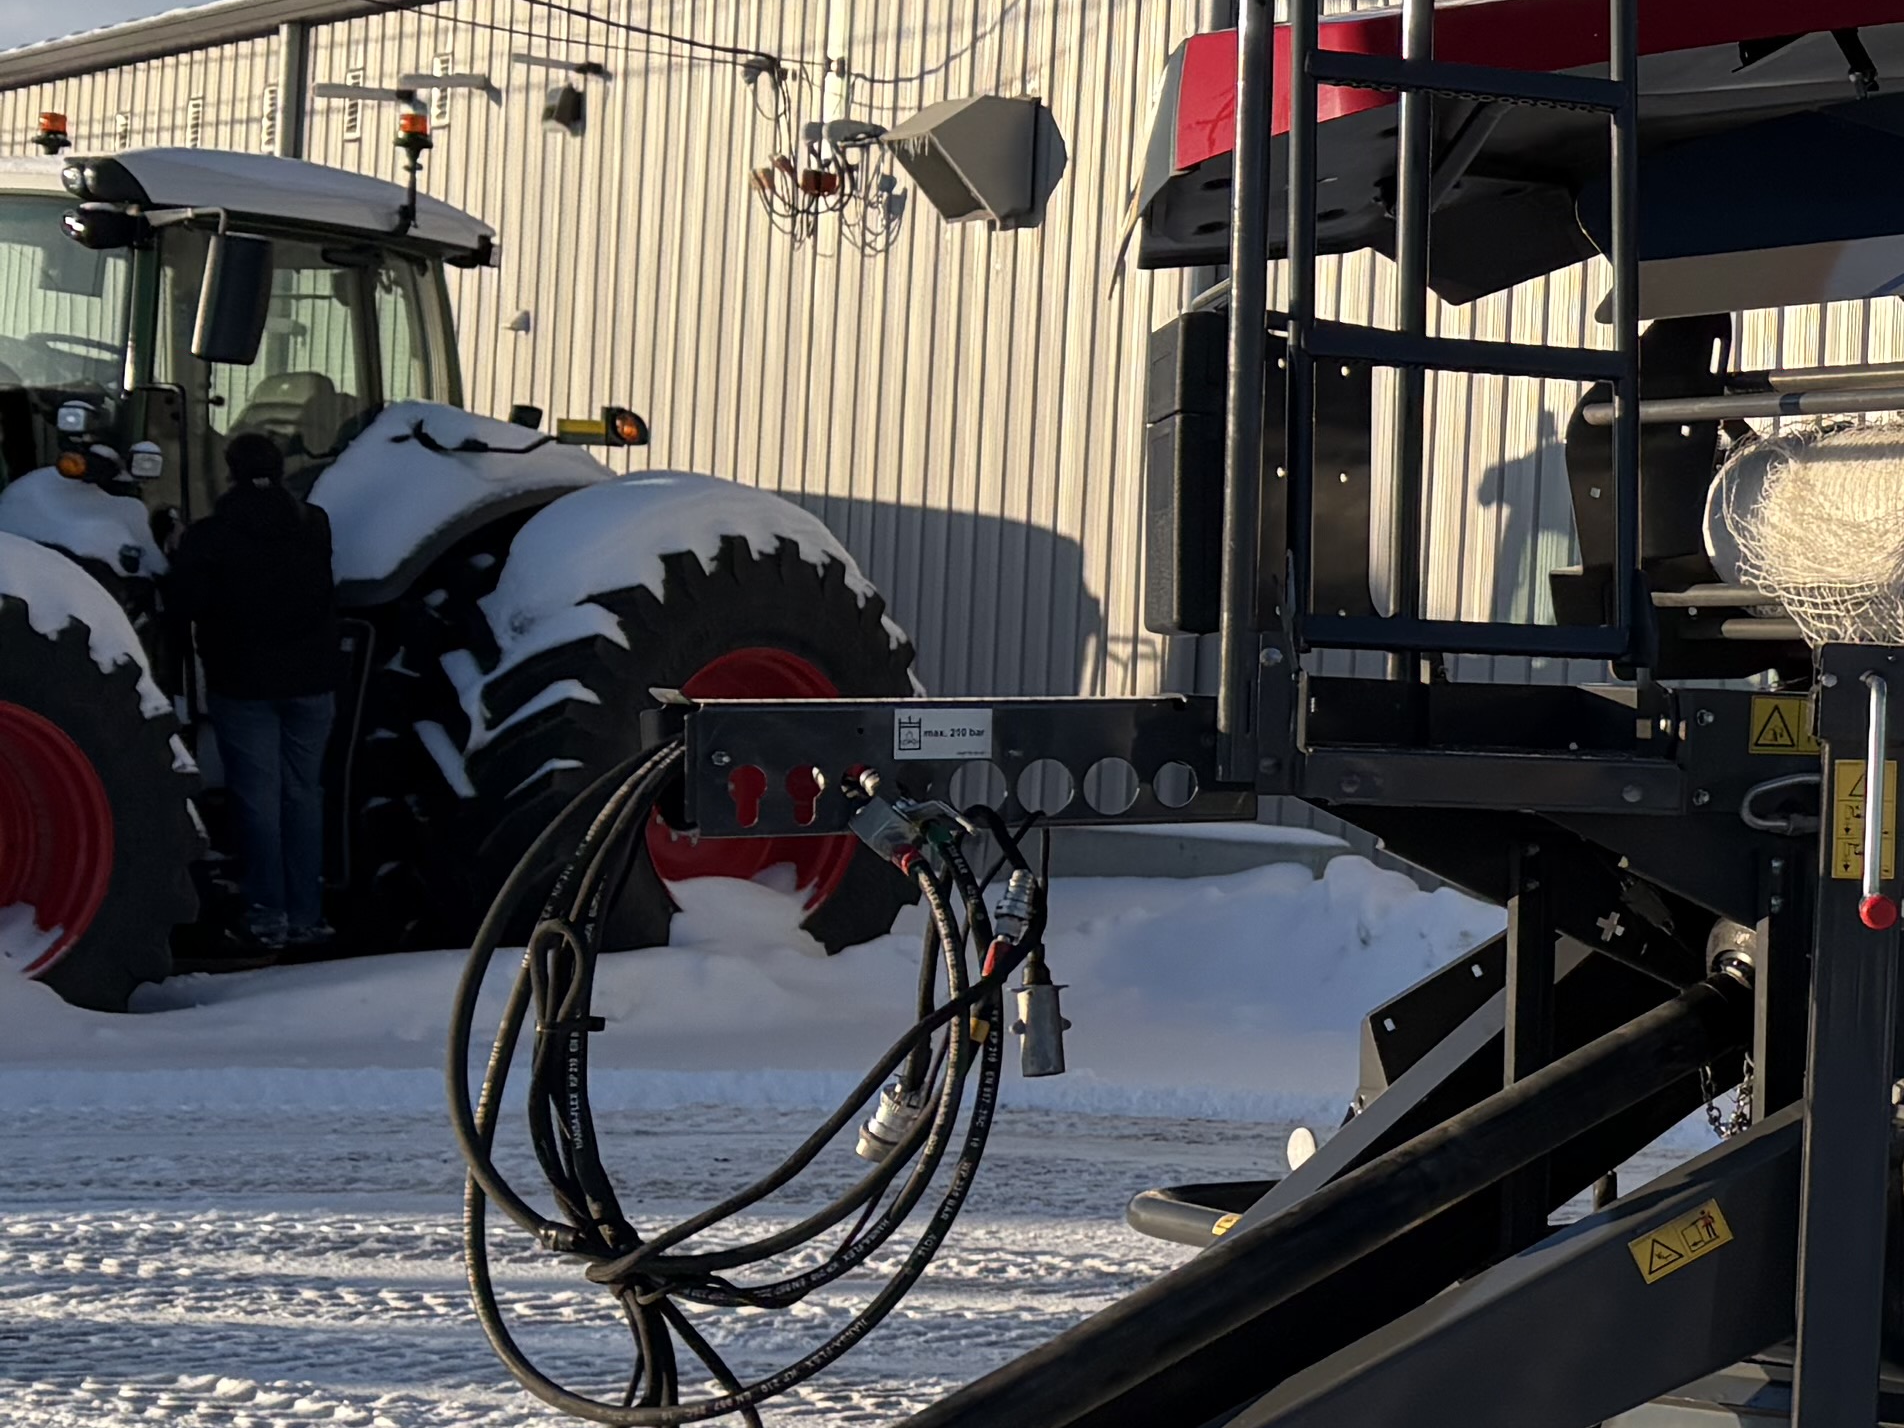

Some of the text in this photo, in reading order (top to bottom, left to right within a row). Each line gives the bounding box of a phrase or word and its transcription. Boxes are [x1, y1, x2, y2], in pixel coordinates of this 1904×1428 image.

[968, 728, 985, 737] bar
[569, 1092, 583, 1149] HANSA-FLEX
[940, 1198, 957, 1221] BAR
